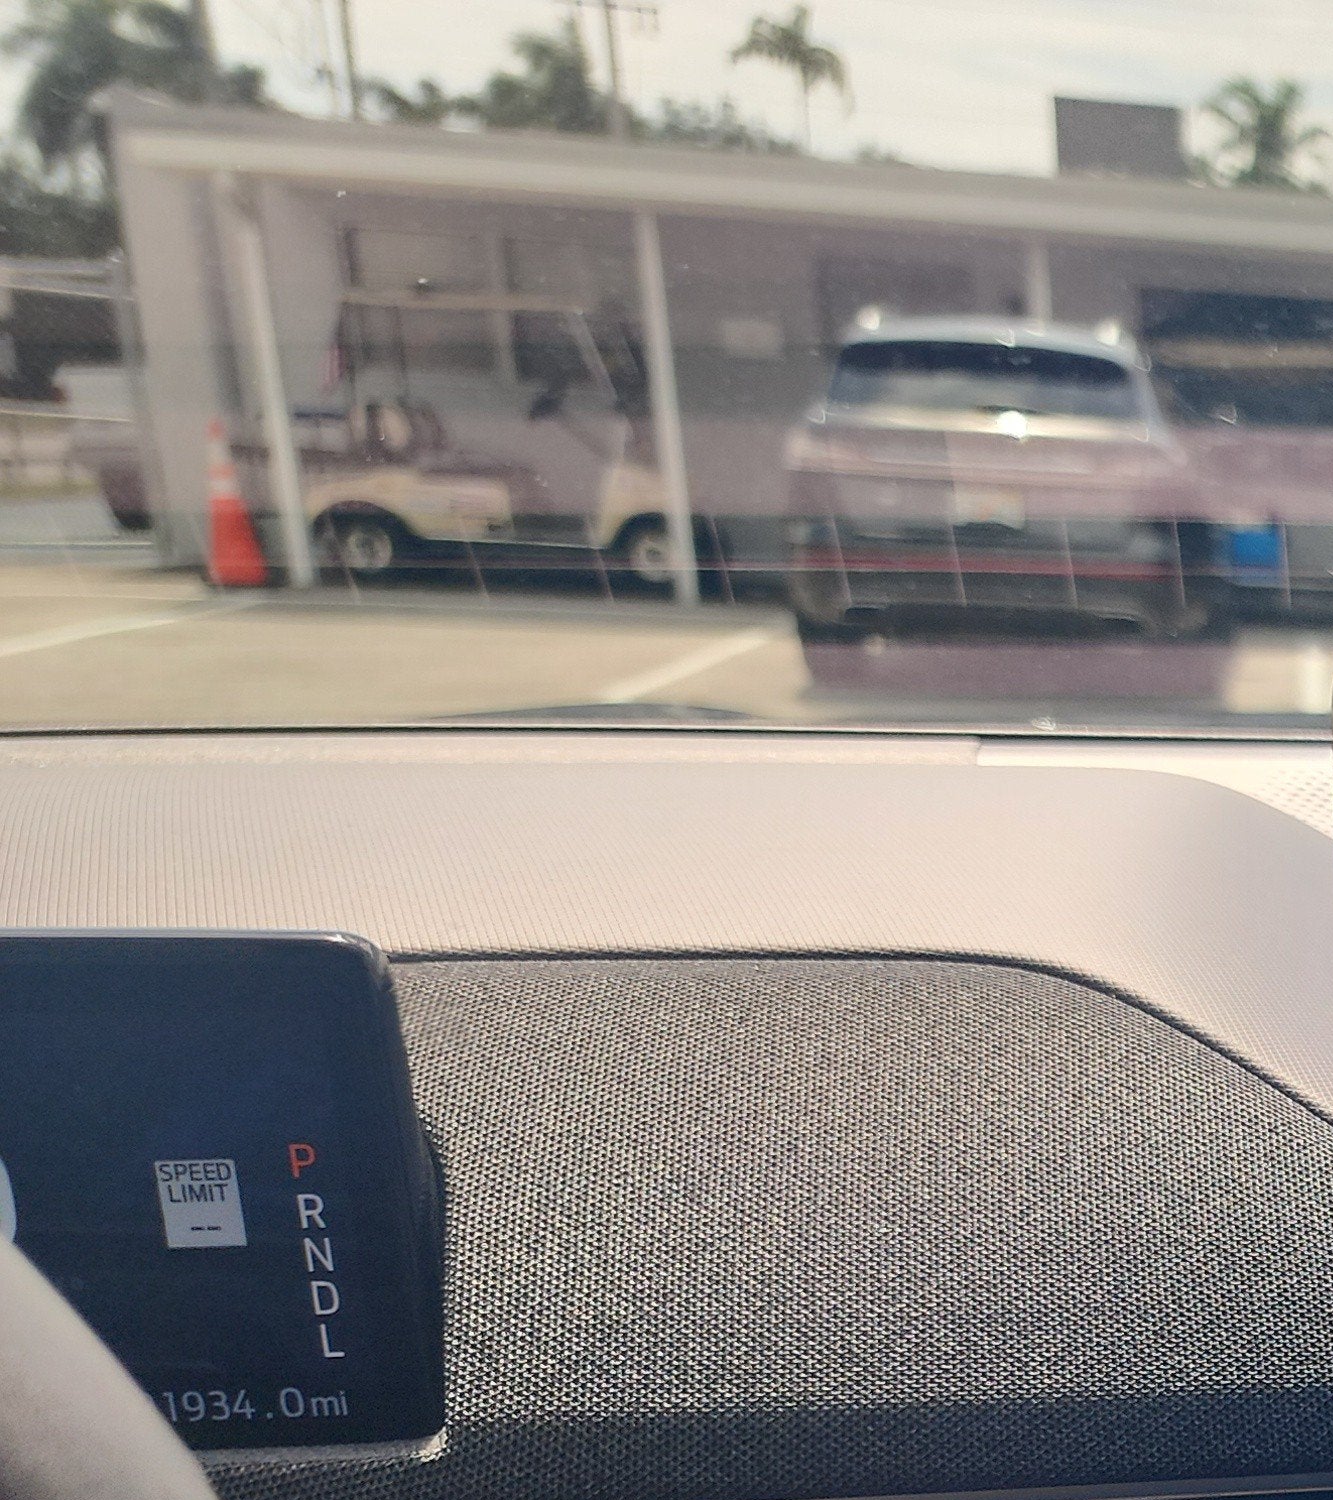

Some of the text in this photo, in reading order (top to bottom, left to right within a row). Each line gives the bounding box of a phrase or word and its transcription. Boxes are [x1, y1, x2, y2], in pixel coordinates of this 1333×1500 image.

[158, 1162, 232, 1182] SPEED
[288, 1143, 316, 1179] P
[168, 1184, 229, 1203] LIMIT
[296, 1193, 327, 1229] R
[303, 1237, 335, 1272] N
[310, 1280, 340, 1316] D
[319, 1323, 346, 1358] L
